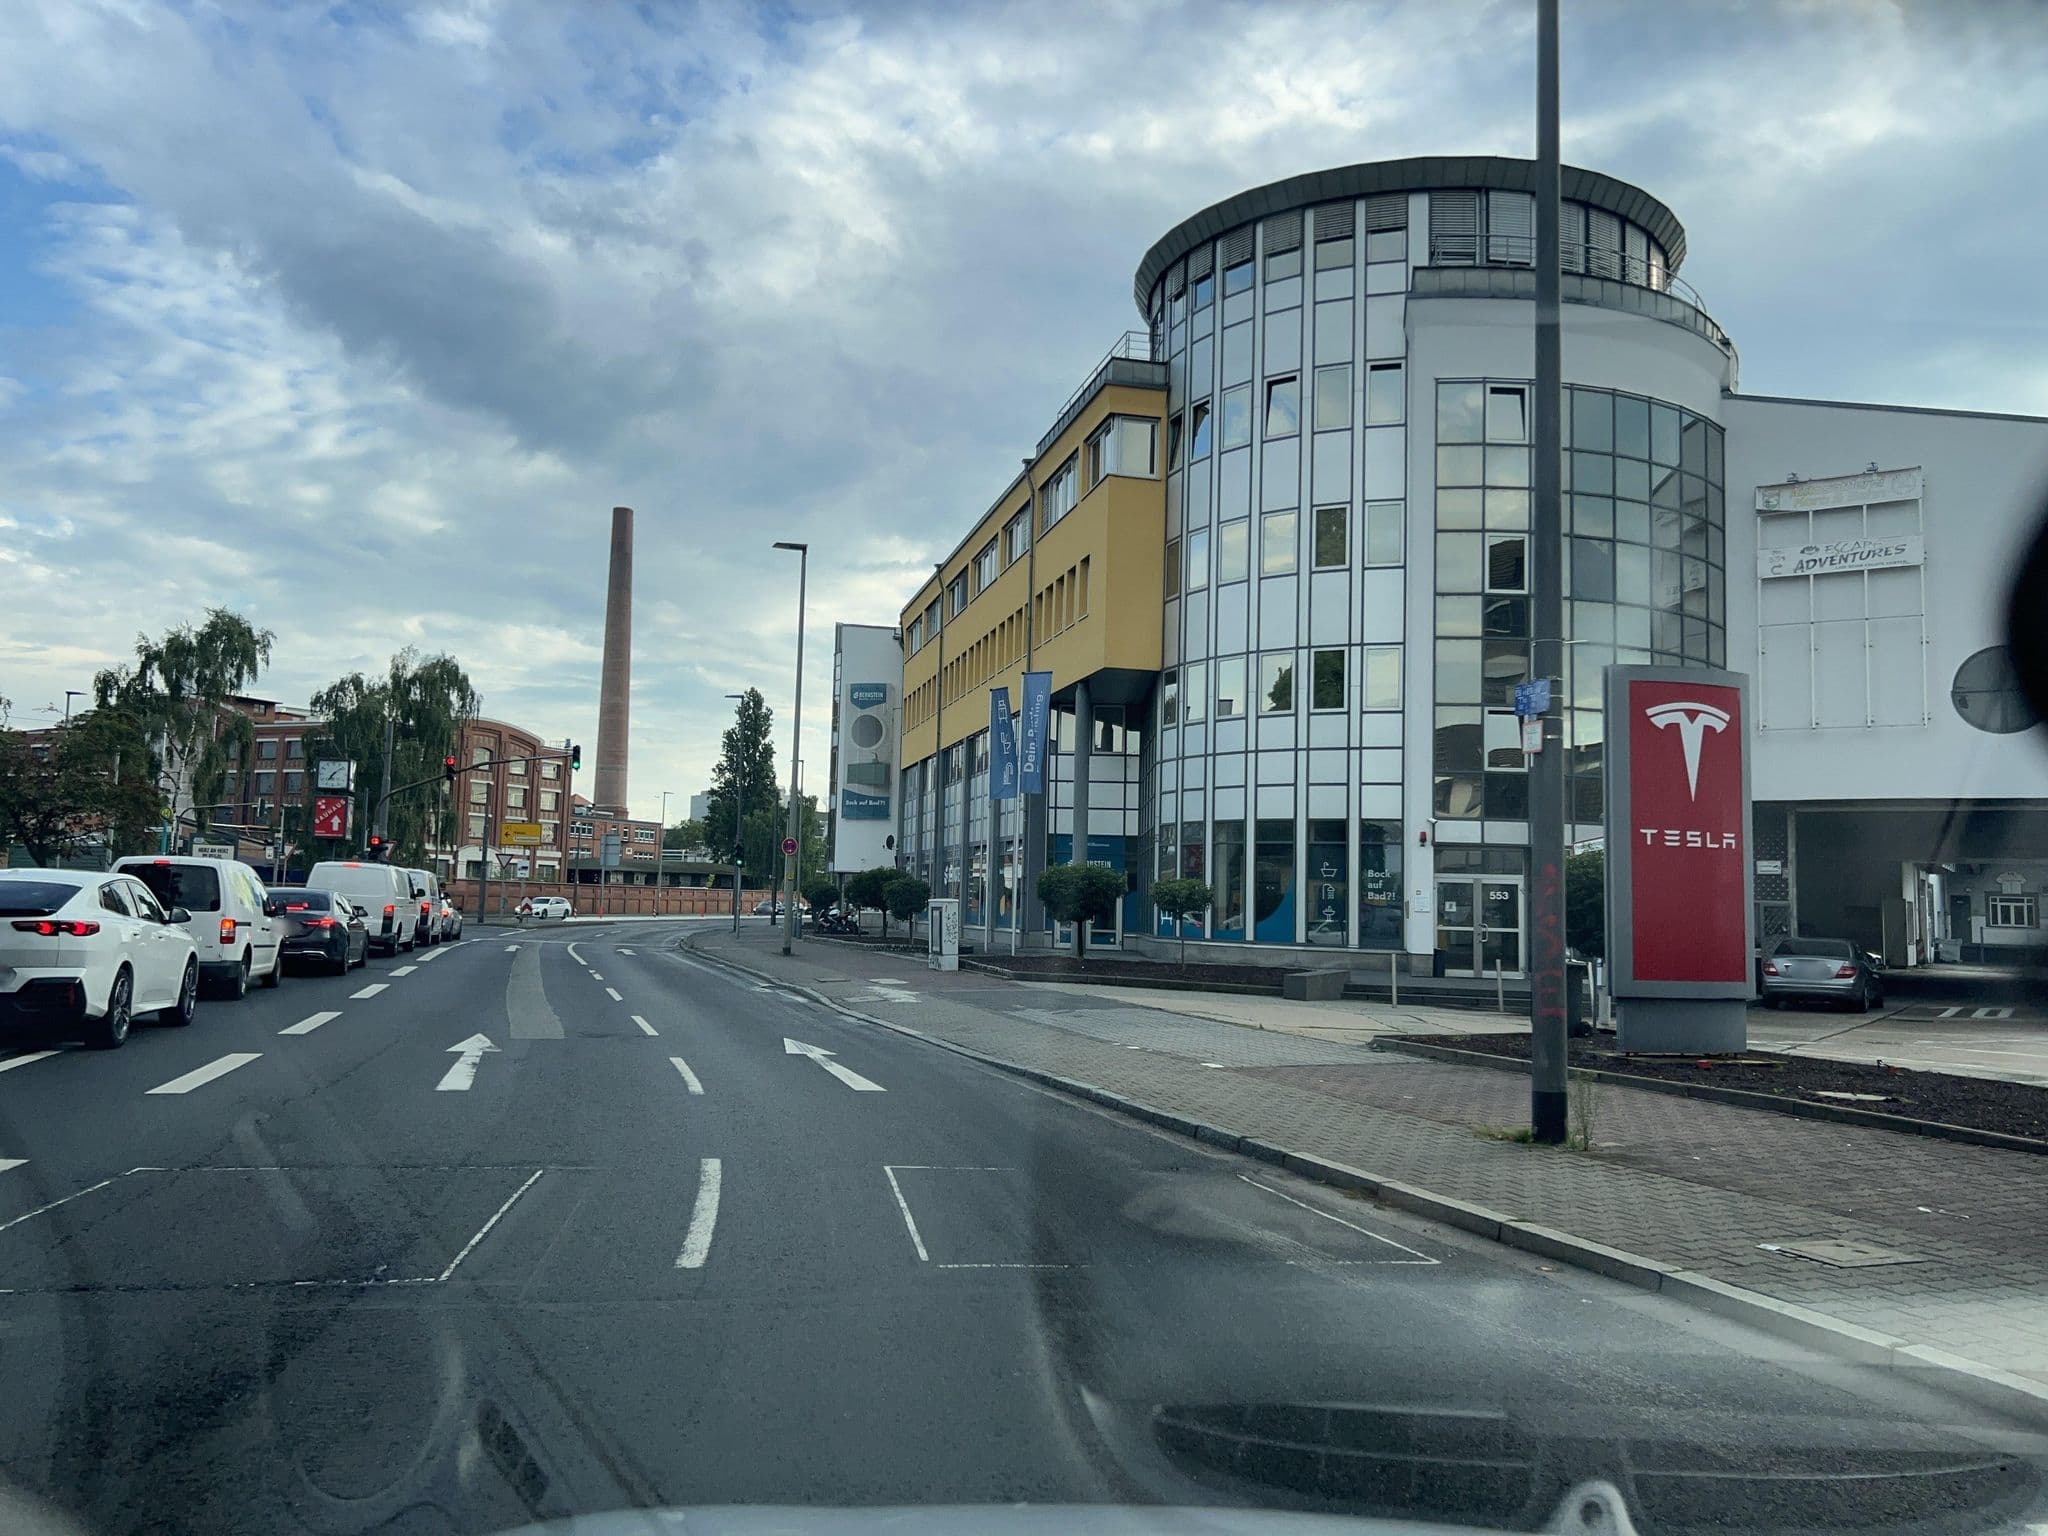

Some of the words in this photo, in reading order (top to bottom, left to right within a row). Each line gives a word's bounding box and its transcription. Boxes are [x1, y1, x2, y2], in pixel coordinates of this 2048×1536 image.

[1793, 543, 1907, 574] ADVENTURES
[1023, 741, 1036, 773] Dein
[314, 799, 346, 824] BAUHAUS
[1639, 828, 1736, 850] TESLA
[1367, 869, 1392, 878] Bock
[1367, 879, 1383, 889] auf
[1367, 891, 1396, 900] Bad?!
[1489, 891, 1509, 900] 553
